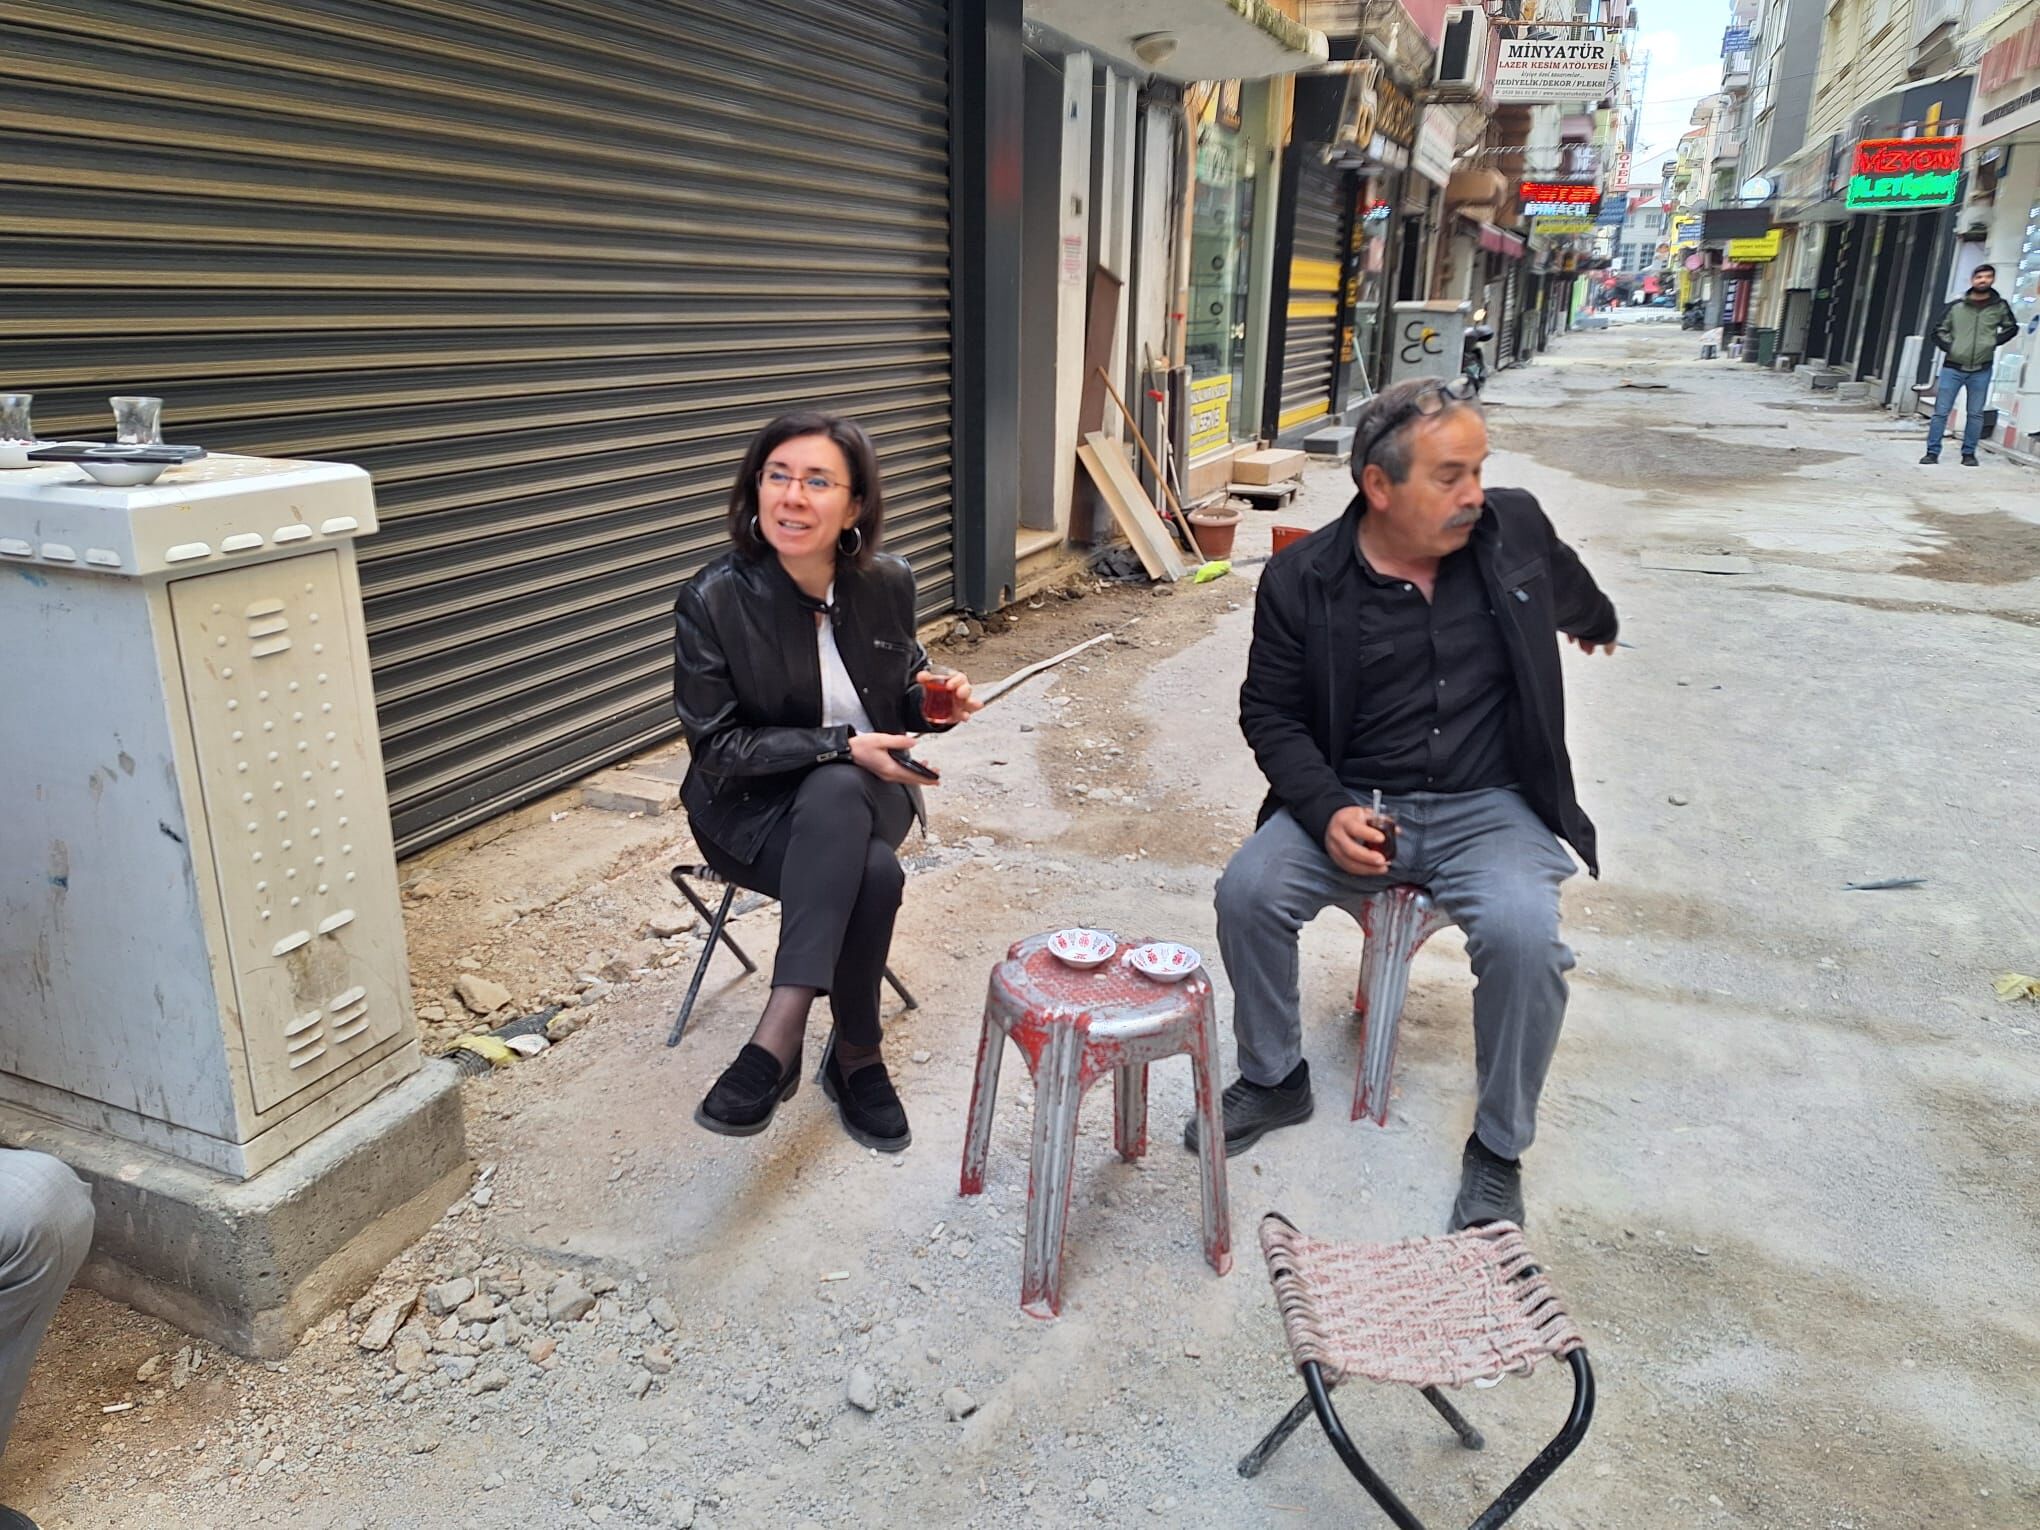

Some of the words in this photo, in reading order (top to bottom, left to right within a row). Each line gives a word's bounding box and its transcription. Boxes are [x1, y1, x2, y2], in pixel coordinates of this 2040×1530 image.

[1508, 42, 1605, 59] MİNYATÜR
[1499, 61, 1528, 69] LAZER
[1616, 154, 1630, 185] OTEL
